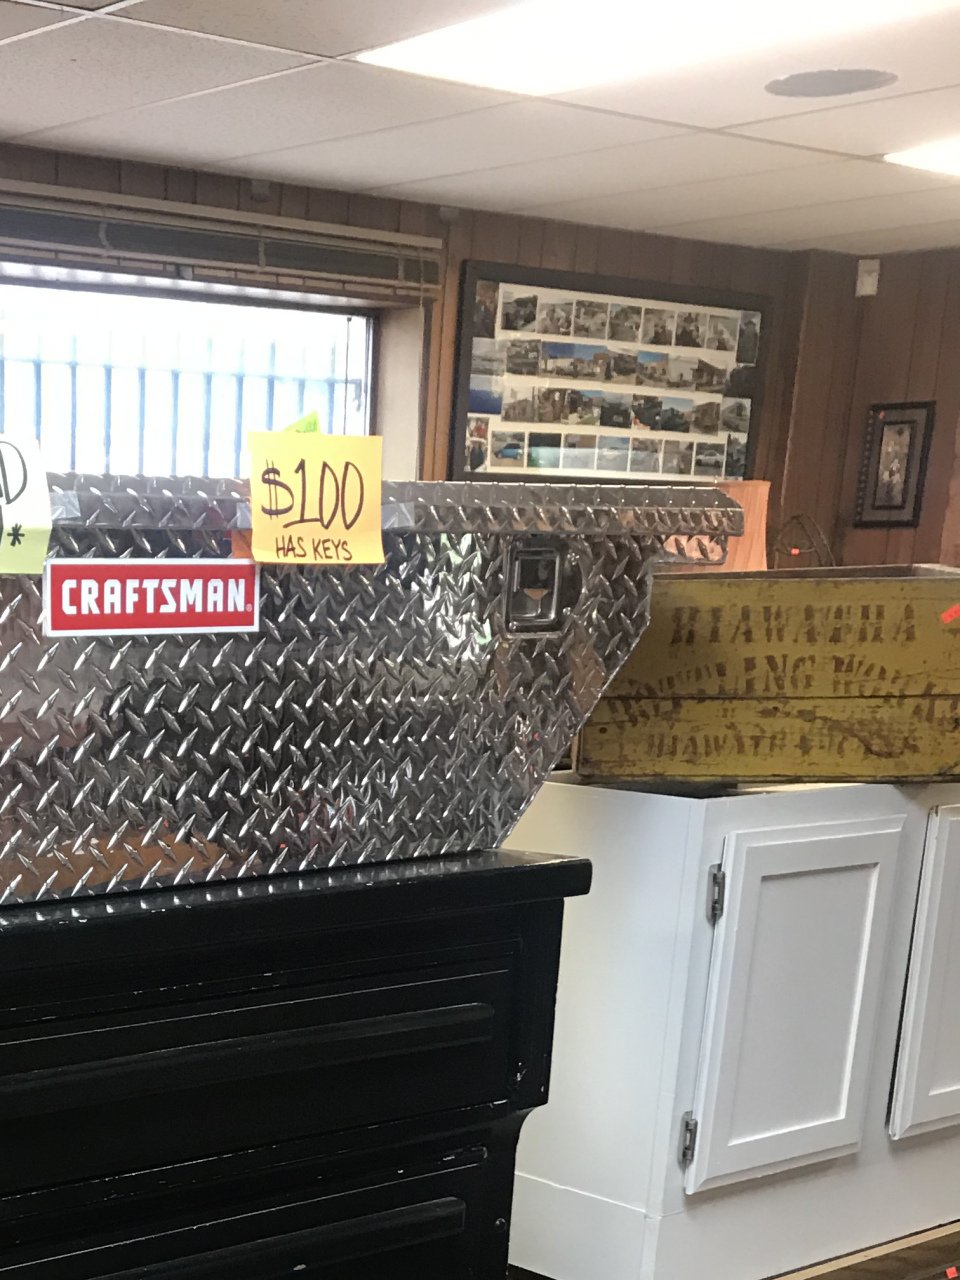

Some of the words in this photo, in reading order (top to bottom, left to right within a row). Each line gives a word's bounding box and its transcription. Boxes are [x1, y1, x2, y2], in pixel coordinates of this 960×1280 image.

[261, 458, 365, 531] $100
[275, 537, 306, 560] HAS
[312, 538, 353, 562] KEYS
[61, 578, 243, 614] CRAFTSMAN
